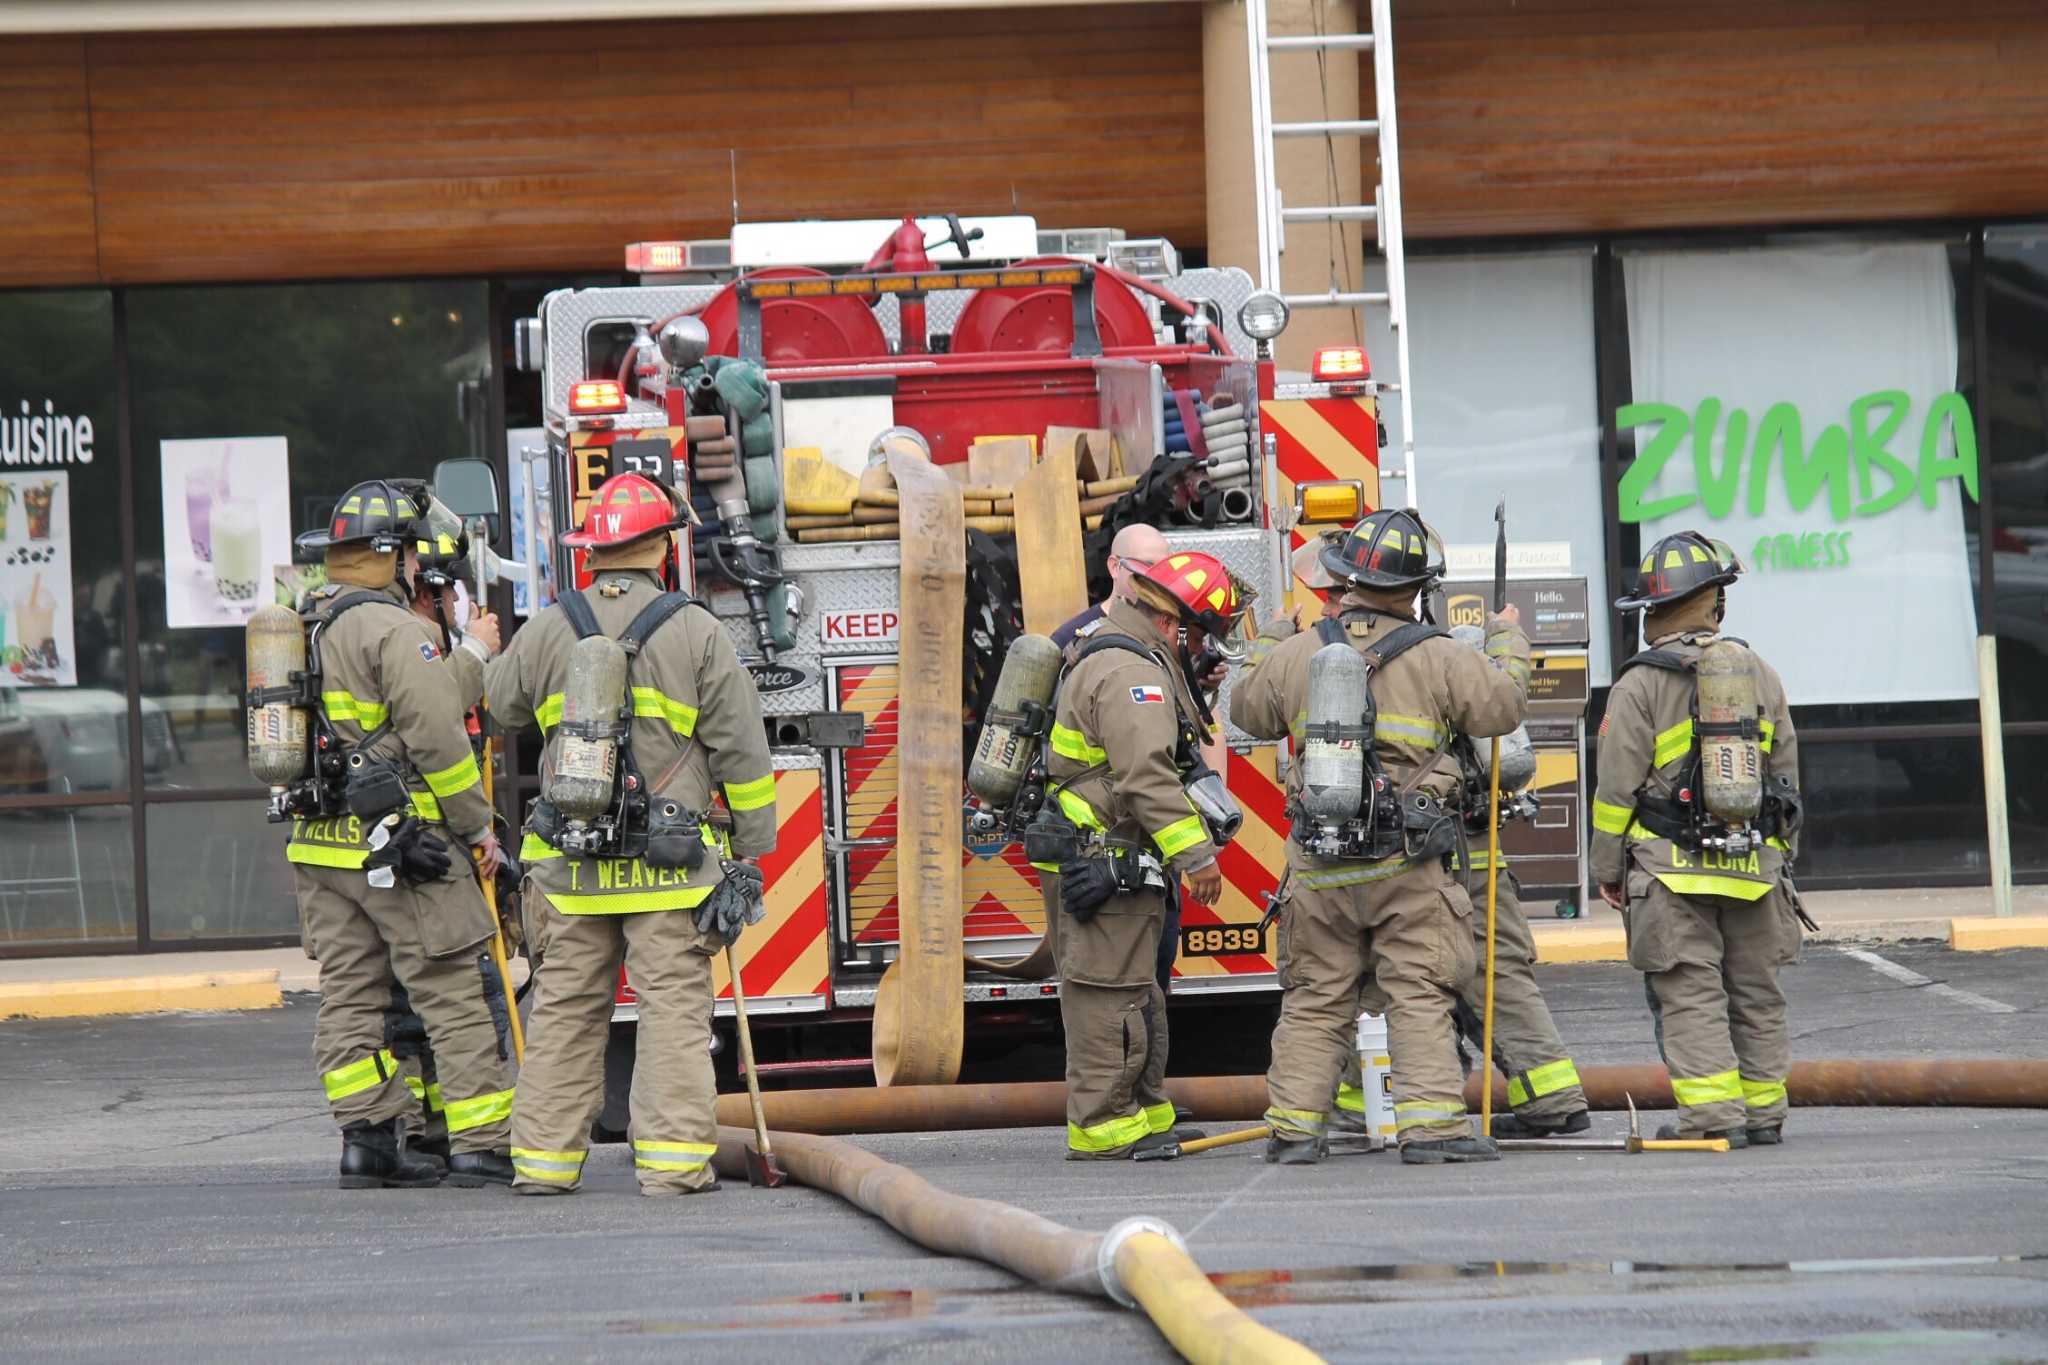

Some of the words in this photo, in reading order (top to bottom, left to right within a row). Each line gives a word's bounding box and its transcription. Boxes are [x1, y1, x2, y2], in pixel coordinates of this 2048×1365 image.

[0, 399, 94, 465] uisine
[1616, 390, 1980, 523] ZUMBA
[1752, 529, 1852, 572] FITNESS
[826, 612, 898, 639] KEEP
[751, 668, 793, 686] ierce
[268, 706, 281, 743] SCOTT
[981, 727, 997, 760] SCOTT
[1001, 733, 1019, 769] SCOTT
[1720, 745, 1733, 781] SCOTT
[1746, 744, 1756, 778] SCOTT
[568, 861, 583, 891] T.
[597, 858, 689, 889] WEAVER
[1702, 848, 1760, 875] LUNA
[1188, 928, 1260, 952] 8939
